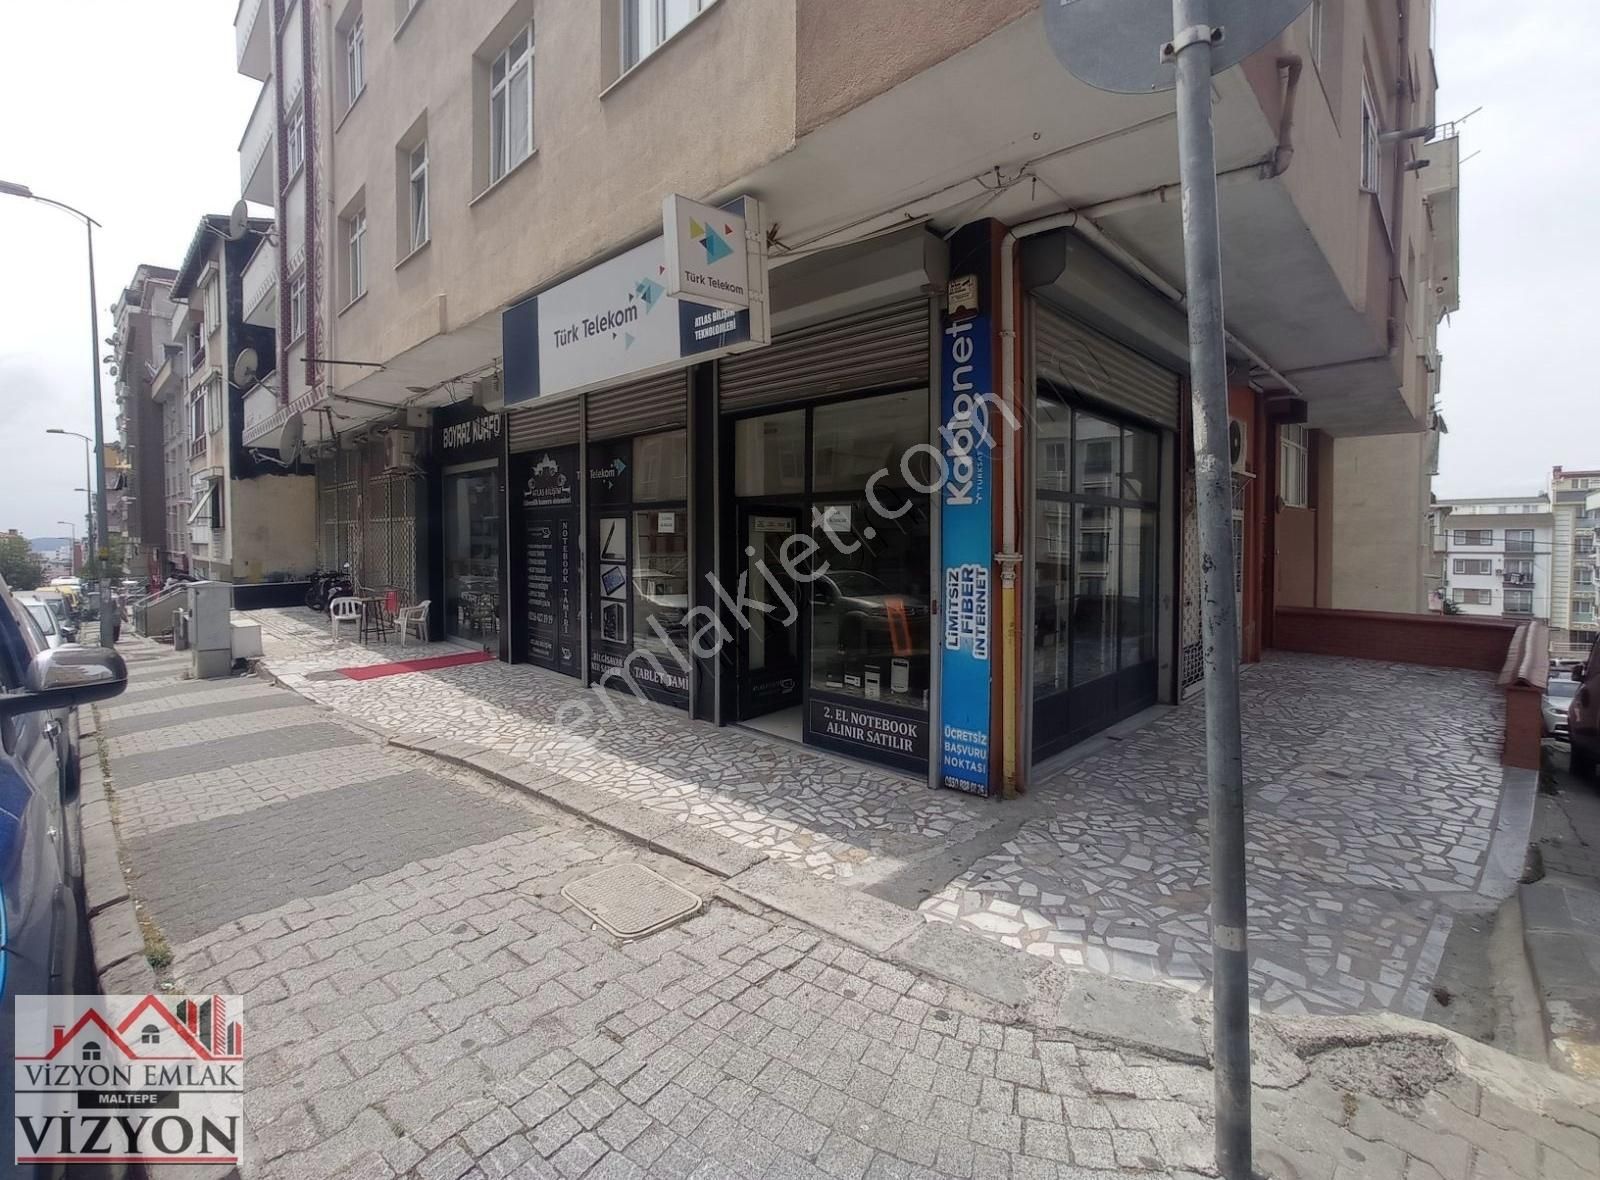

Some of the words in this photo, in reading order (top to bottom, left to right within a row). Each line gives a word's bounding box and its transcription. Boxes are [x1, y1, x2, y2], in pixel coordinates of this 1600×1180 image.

[685, 271, 706, 286] Türk
[708, 276, 744, 295] Telekom
[554, 325, 580, 349] Türk
[582, 304, 638, 338] Telekom
[695, 313, 712, 328] ATLAS
[443, 421, 471, 449] BOYRAZ
[590, 468, 615, 480] Telekom
[948, 570, 959, 648] LİMİTSİZ
[961, 567, 974, 634] FİBER
[975, 570, 987, 657] İNTERNET
[634, 667, 665, 684] TABLET
[666, 674, 688, 690] TAMİ
[823, 706, 833, 719] 2.
[836, 709, 849, 723] EL
[851, 712, 918, 738] NOTEBOOK
[827, 721, 864, 741] ALINIR
[867, 730, 913, 752] SATILIR
[945, 726, 987, 745] ÜCRETSİZ
[945, 743, 987, 760] BAŞVURU
[945, 758, 986, 774] NOKTASI
